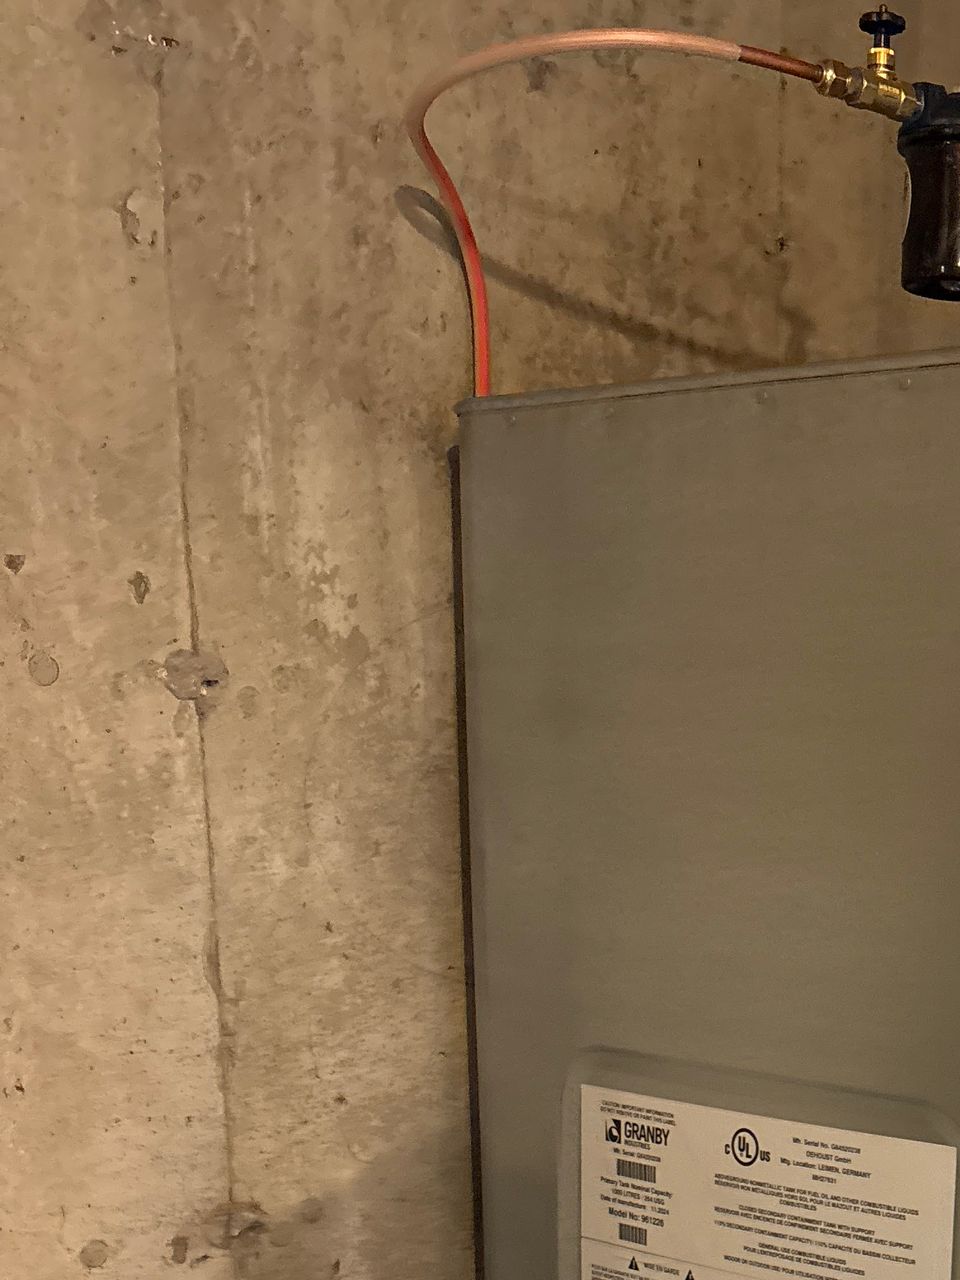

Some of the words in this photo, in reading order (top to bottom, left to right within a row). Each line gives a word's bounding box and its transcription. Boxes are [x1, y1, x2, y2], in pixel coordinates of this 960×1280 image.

[624, 1121, 670, 1147] GRANBY
[760, 1150, 771, 1163] US
[609, 1207, 627, 1219] Model
